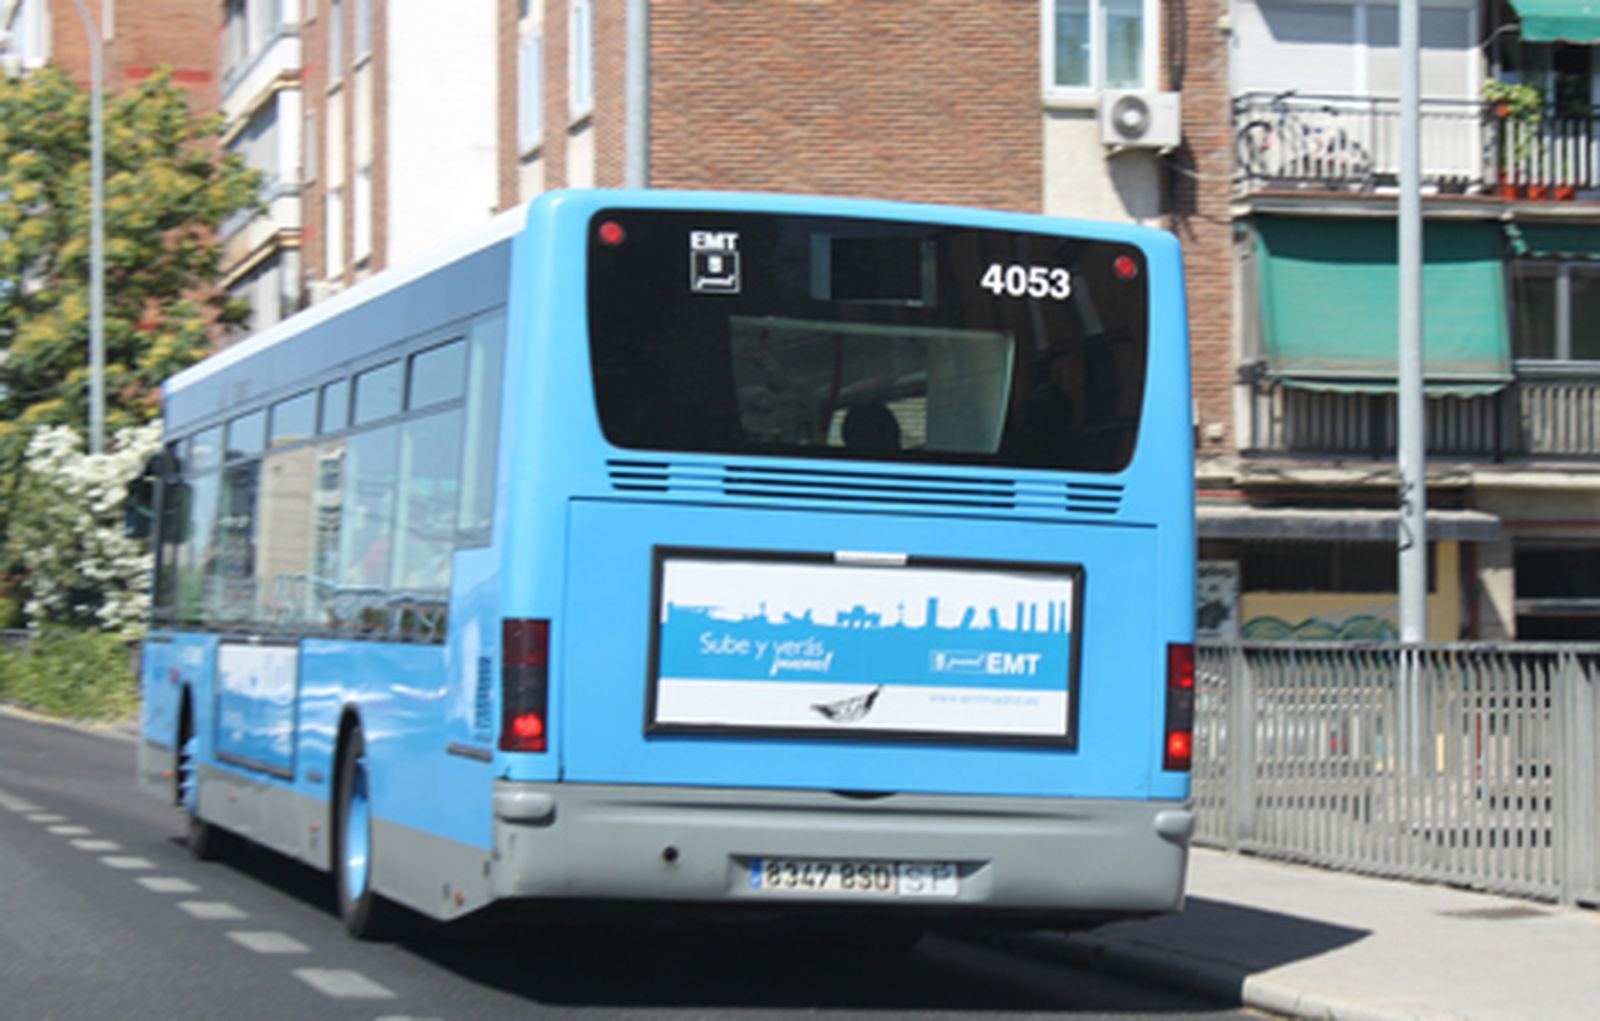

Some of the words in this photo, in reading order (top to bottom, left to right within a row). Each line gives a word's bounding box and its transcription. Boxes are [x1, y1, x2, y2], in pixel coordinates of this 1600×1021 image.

[690, 230, 740, 250] EMT
[980, 263, 1071, 299] 4053
[699, 631, 752, 656] Sube
[755, 639, 769, 661] y
[772, 635, 825, 657] verás
[985, 651, 1042, 676] EMT
[904, 864, 952, 892] SP
